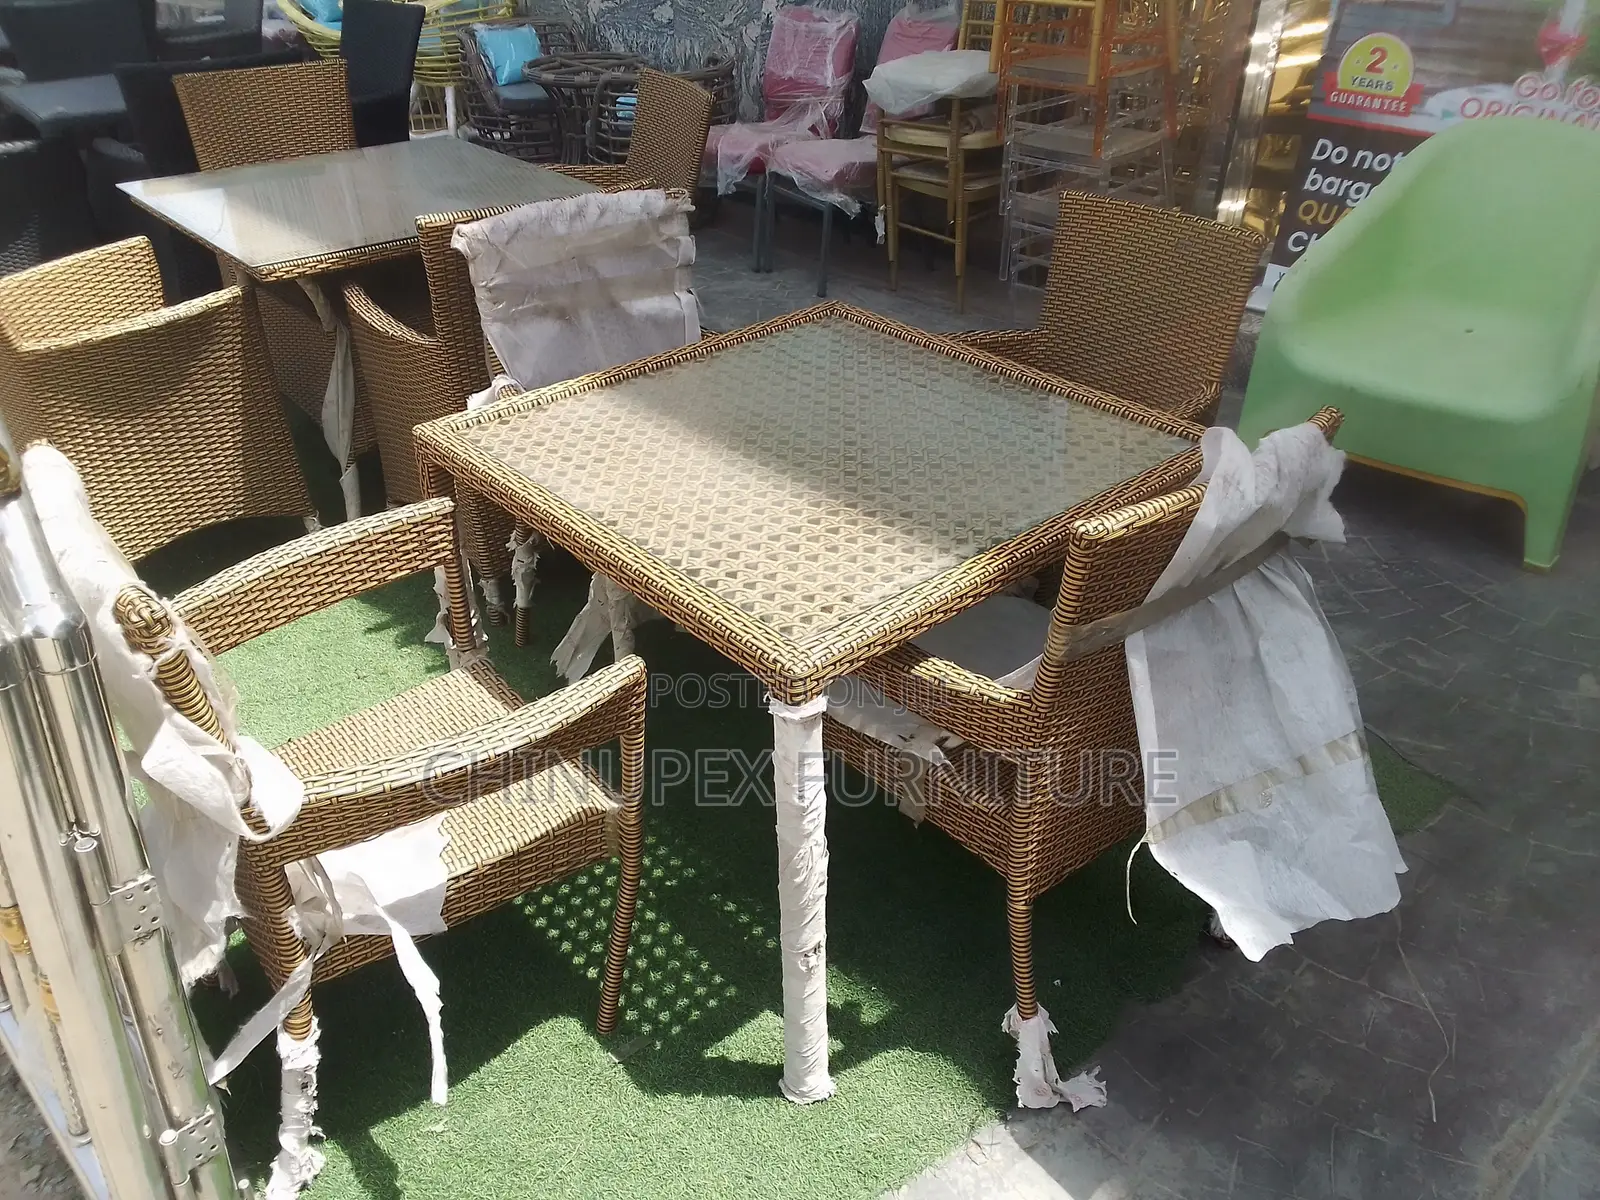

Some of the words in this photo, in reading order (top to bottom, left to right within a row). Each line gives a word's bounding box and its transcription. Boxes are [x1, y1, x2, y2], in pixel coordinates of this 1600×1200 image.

[1365, 46, 1388, 74] 2
[1351, 76, 1395, 93] YEARS
[1330, 91, 1409, 113] GUARANTEE
[1310, 138, 1349, 165] Do
[1303, 167, 1372, 207] barg
